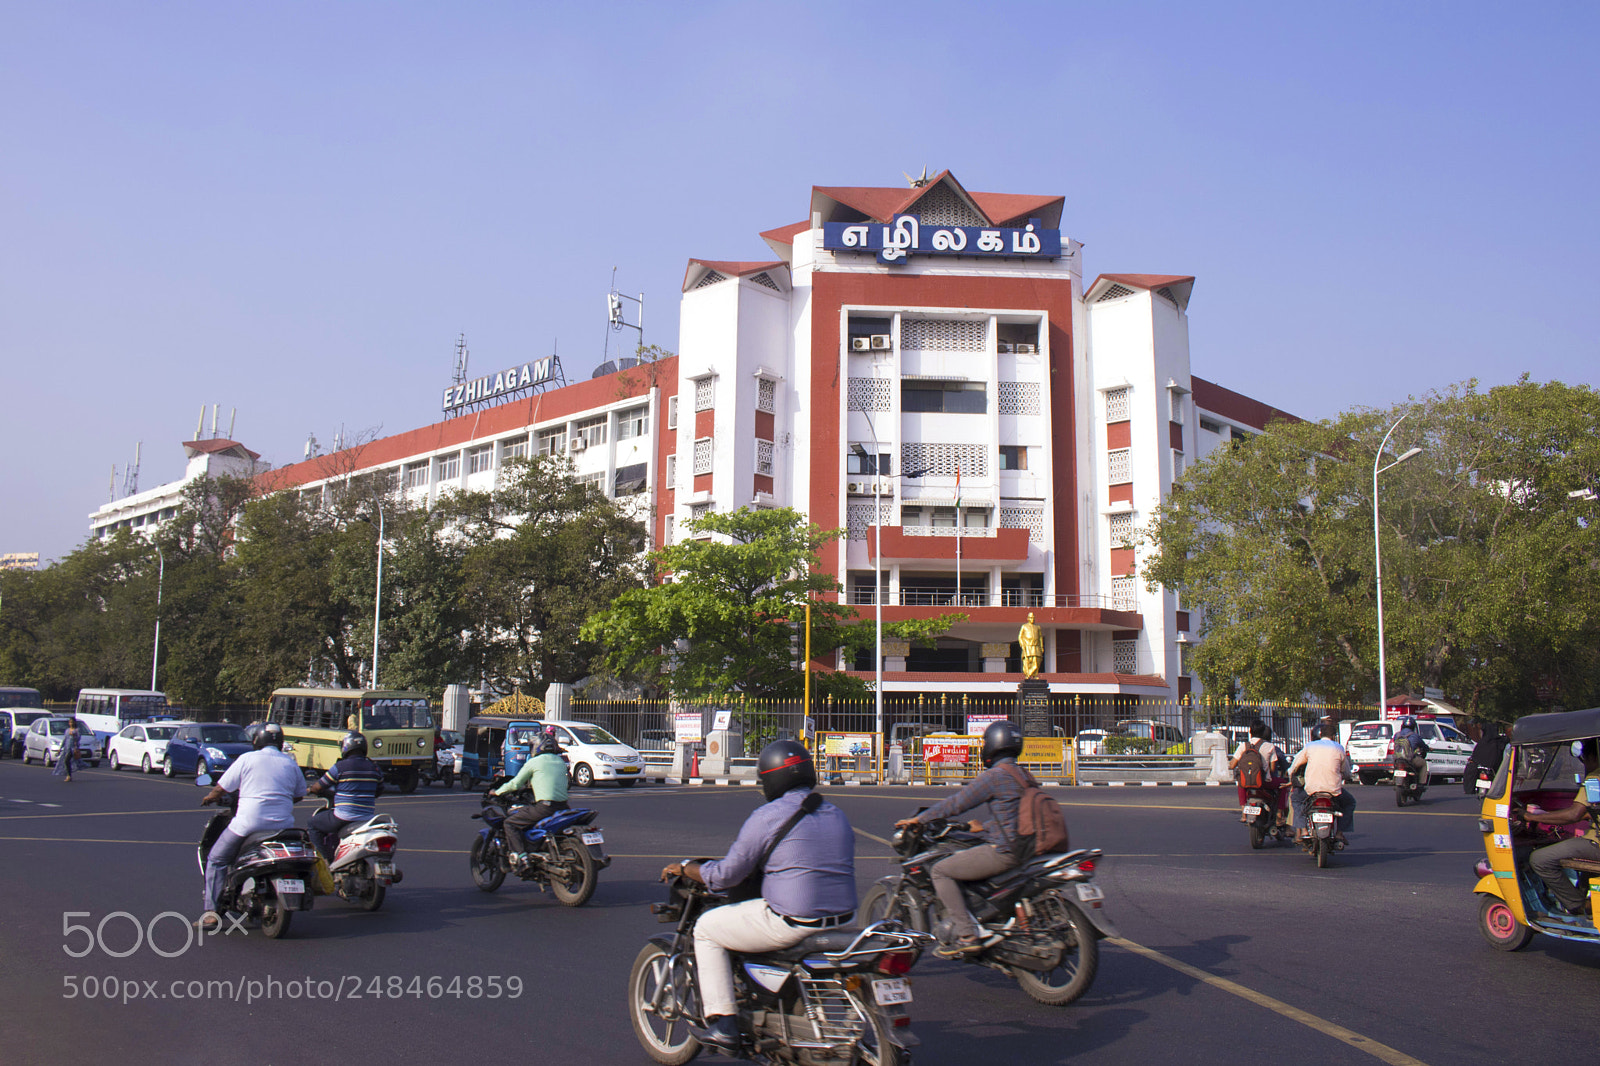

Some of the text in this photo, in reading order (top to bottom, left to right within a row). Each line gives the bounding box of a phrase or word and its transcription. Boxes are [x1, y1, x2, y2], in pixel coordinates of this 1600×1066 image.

[841, 215, 1041, 261] எழிலகம்
[443, 358, 550, 408] EZHILAGAM
[363, 699, 426, 707] LIMRA
